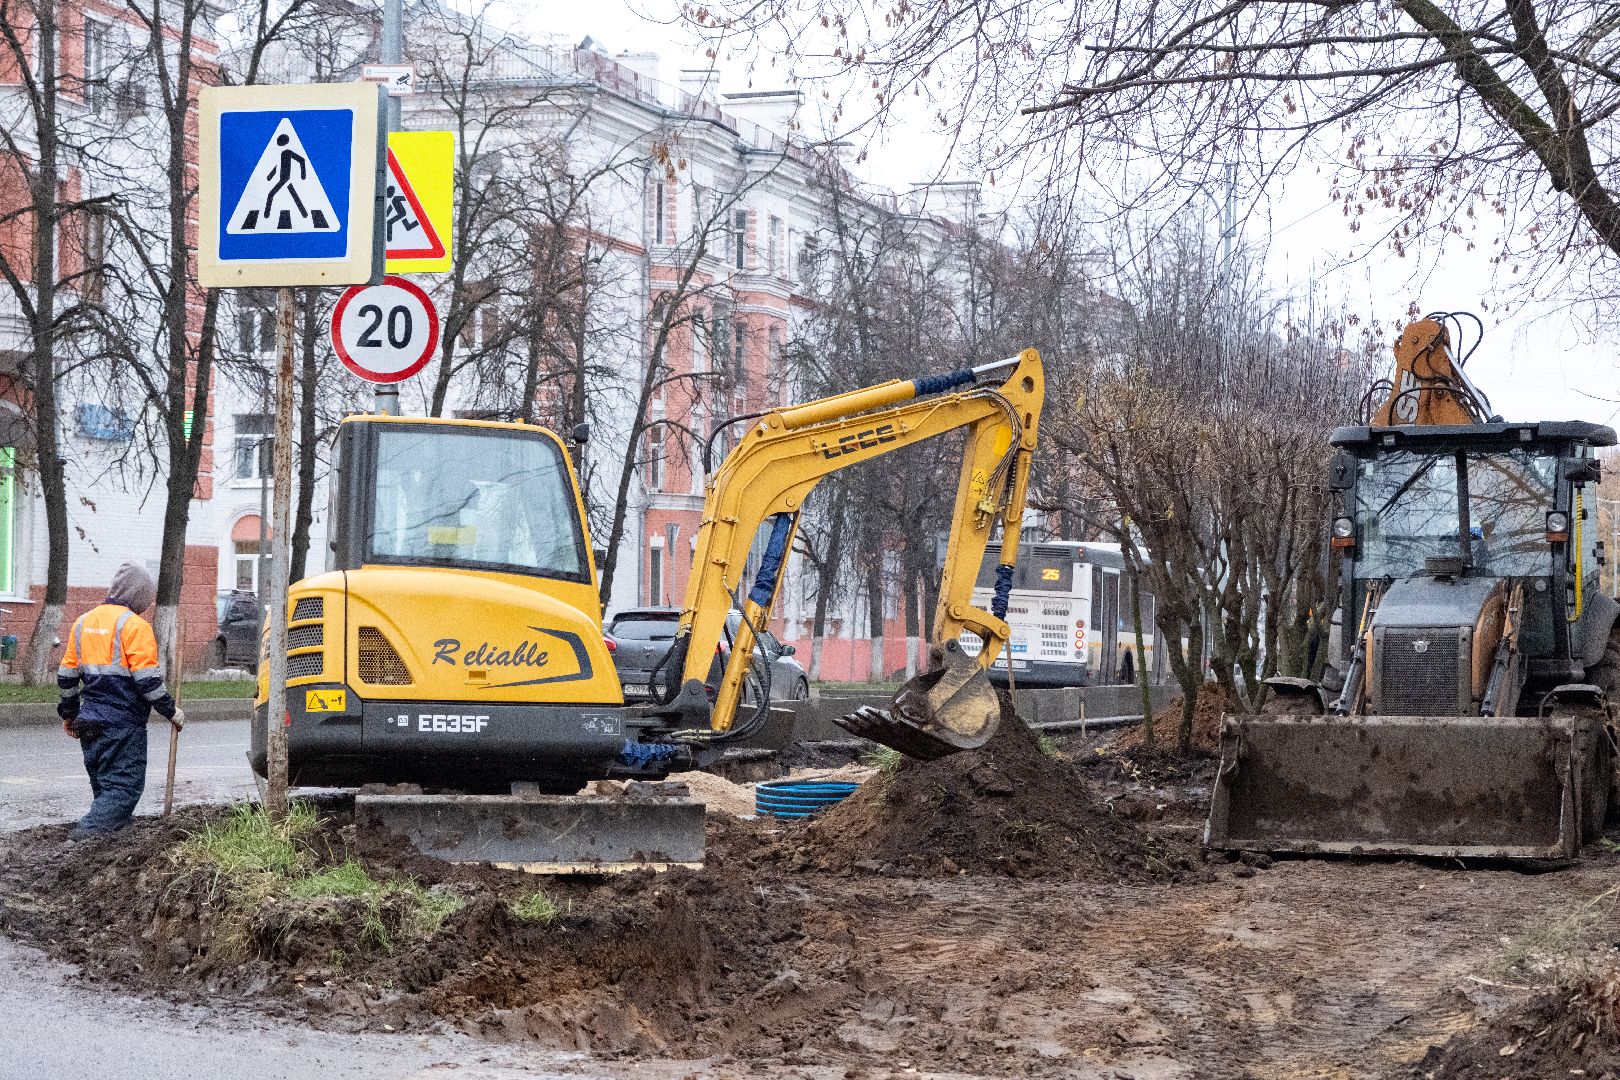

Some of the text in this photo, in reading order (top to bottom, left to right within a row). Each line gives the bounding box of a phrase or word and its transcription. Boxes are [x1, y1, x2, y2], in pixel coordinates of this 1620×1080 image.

[356, 304, 413, 349] 20
[1042, 568, 1060, 580] 25
[432, 638, 549, 667] Reliable
[418, 714, 490, 733] E635F
